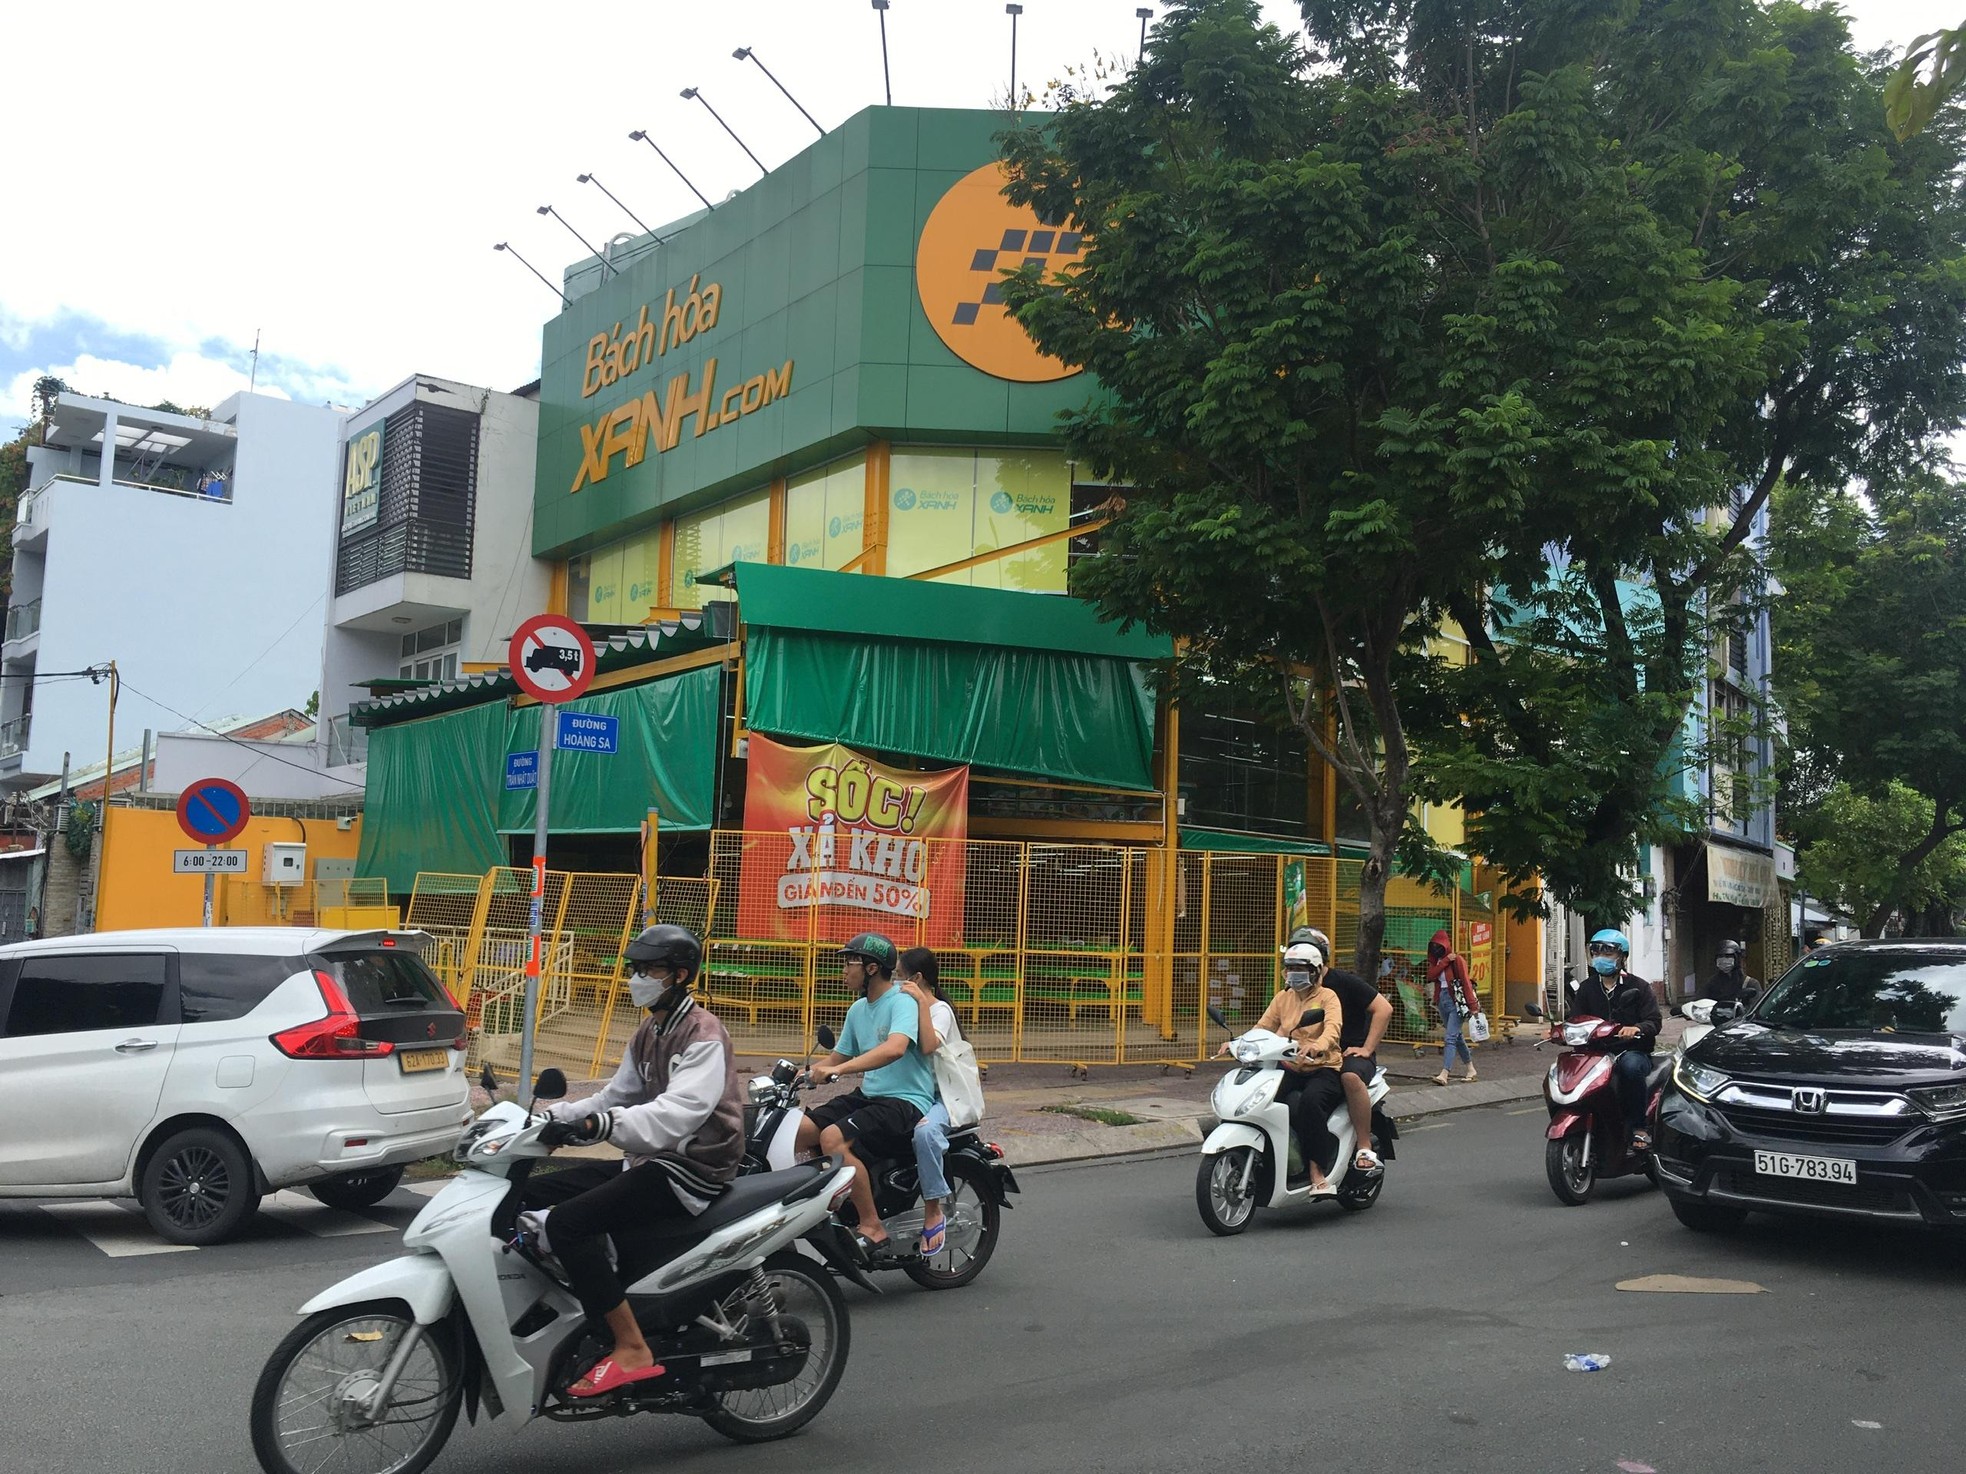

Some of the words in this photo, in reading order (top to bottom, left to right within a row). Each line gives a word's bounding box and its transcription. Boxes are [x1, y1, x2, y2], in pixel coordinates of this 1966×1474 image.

[581, 304, 656, 398] Bách
[659, 273, 723, 357] hóa
[918, 500, 957, 511] XANH
[1016, 504, 1054, 514] XANH
[572, 718, 607, 731] ĐƯỜNG
[564, 732, 597, 748] HOÀNG
[598, 737, 611, 749] SA
[787, 812, 836, 871] XẢ
[849, 827, 927, 883] KHO
[873, 882, 923, 913] 50%
[1758, 1154, 1854, 1181] 51G-783.94
